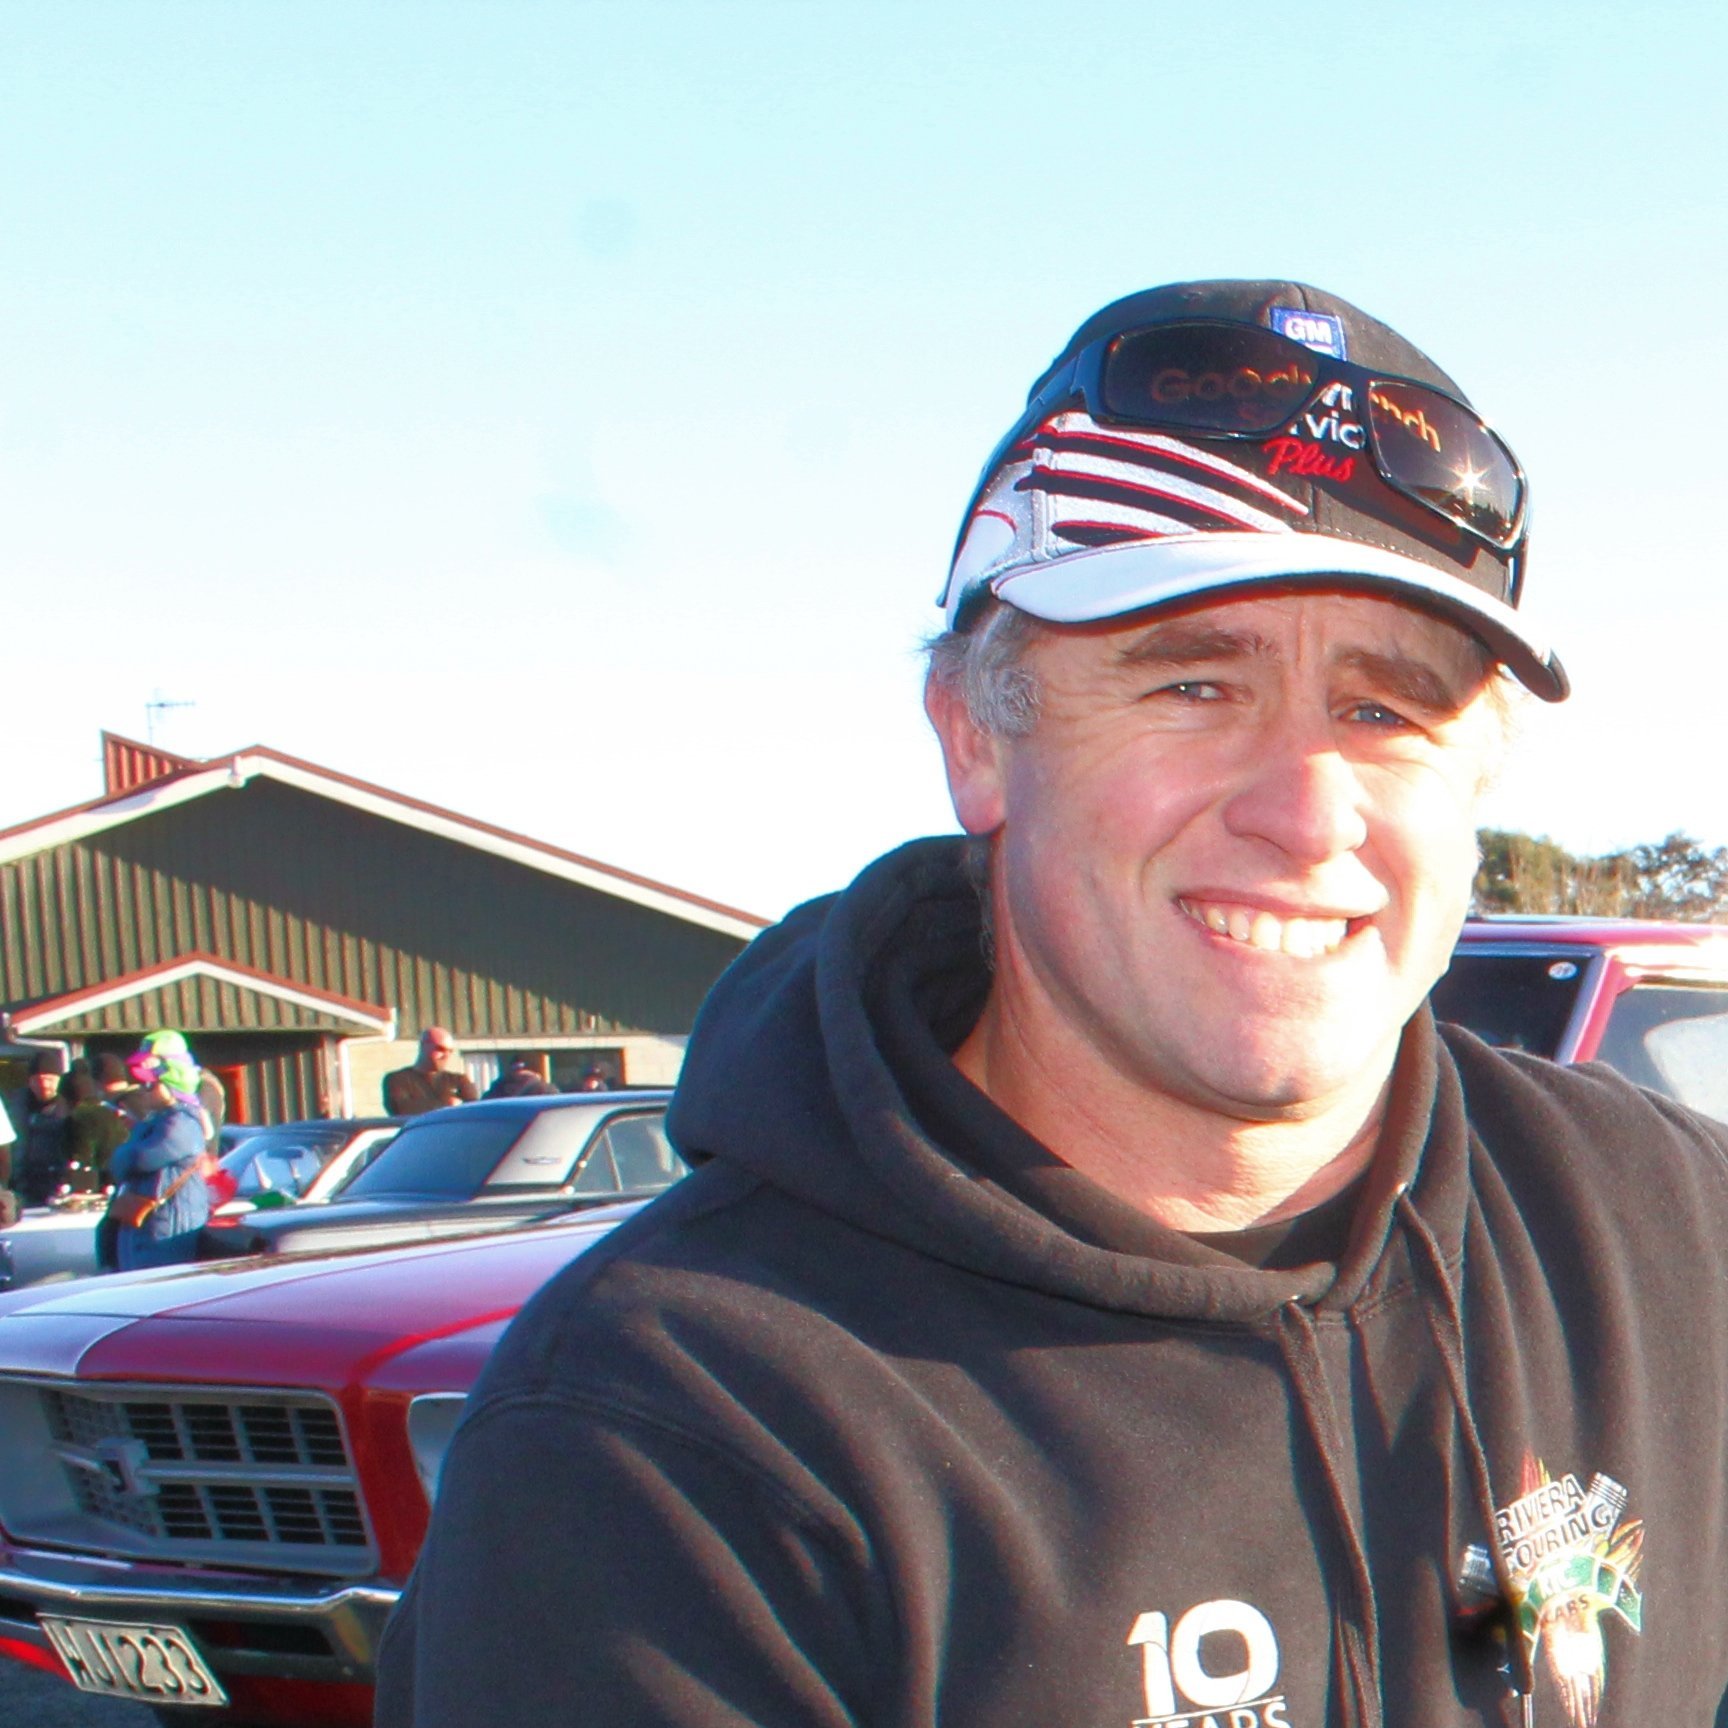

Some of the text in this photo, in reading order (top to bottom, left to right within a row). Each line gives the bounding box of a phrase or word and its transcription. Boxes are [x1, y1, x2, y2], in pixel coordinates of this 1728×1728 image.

[1285, 317, 1332, 344] GM
[1262, 436, 1356, 483] Plus
[52, 1624, 212, 1695] HJ1233
[1126, 1599, 1280, 1717] 10
